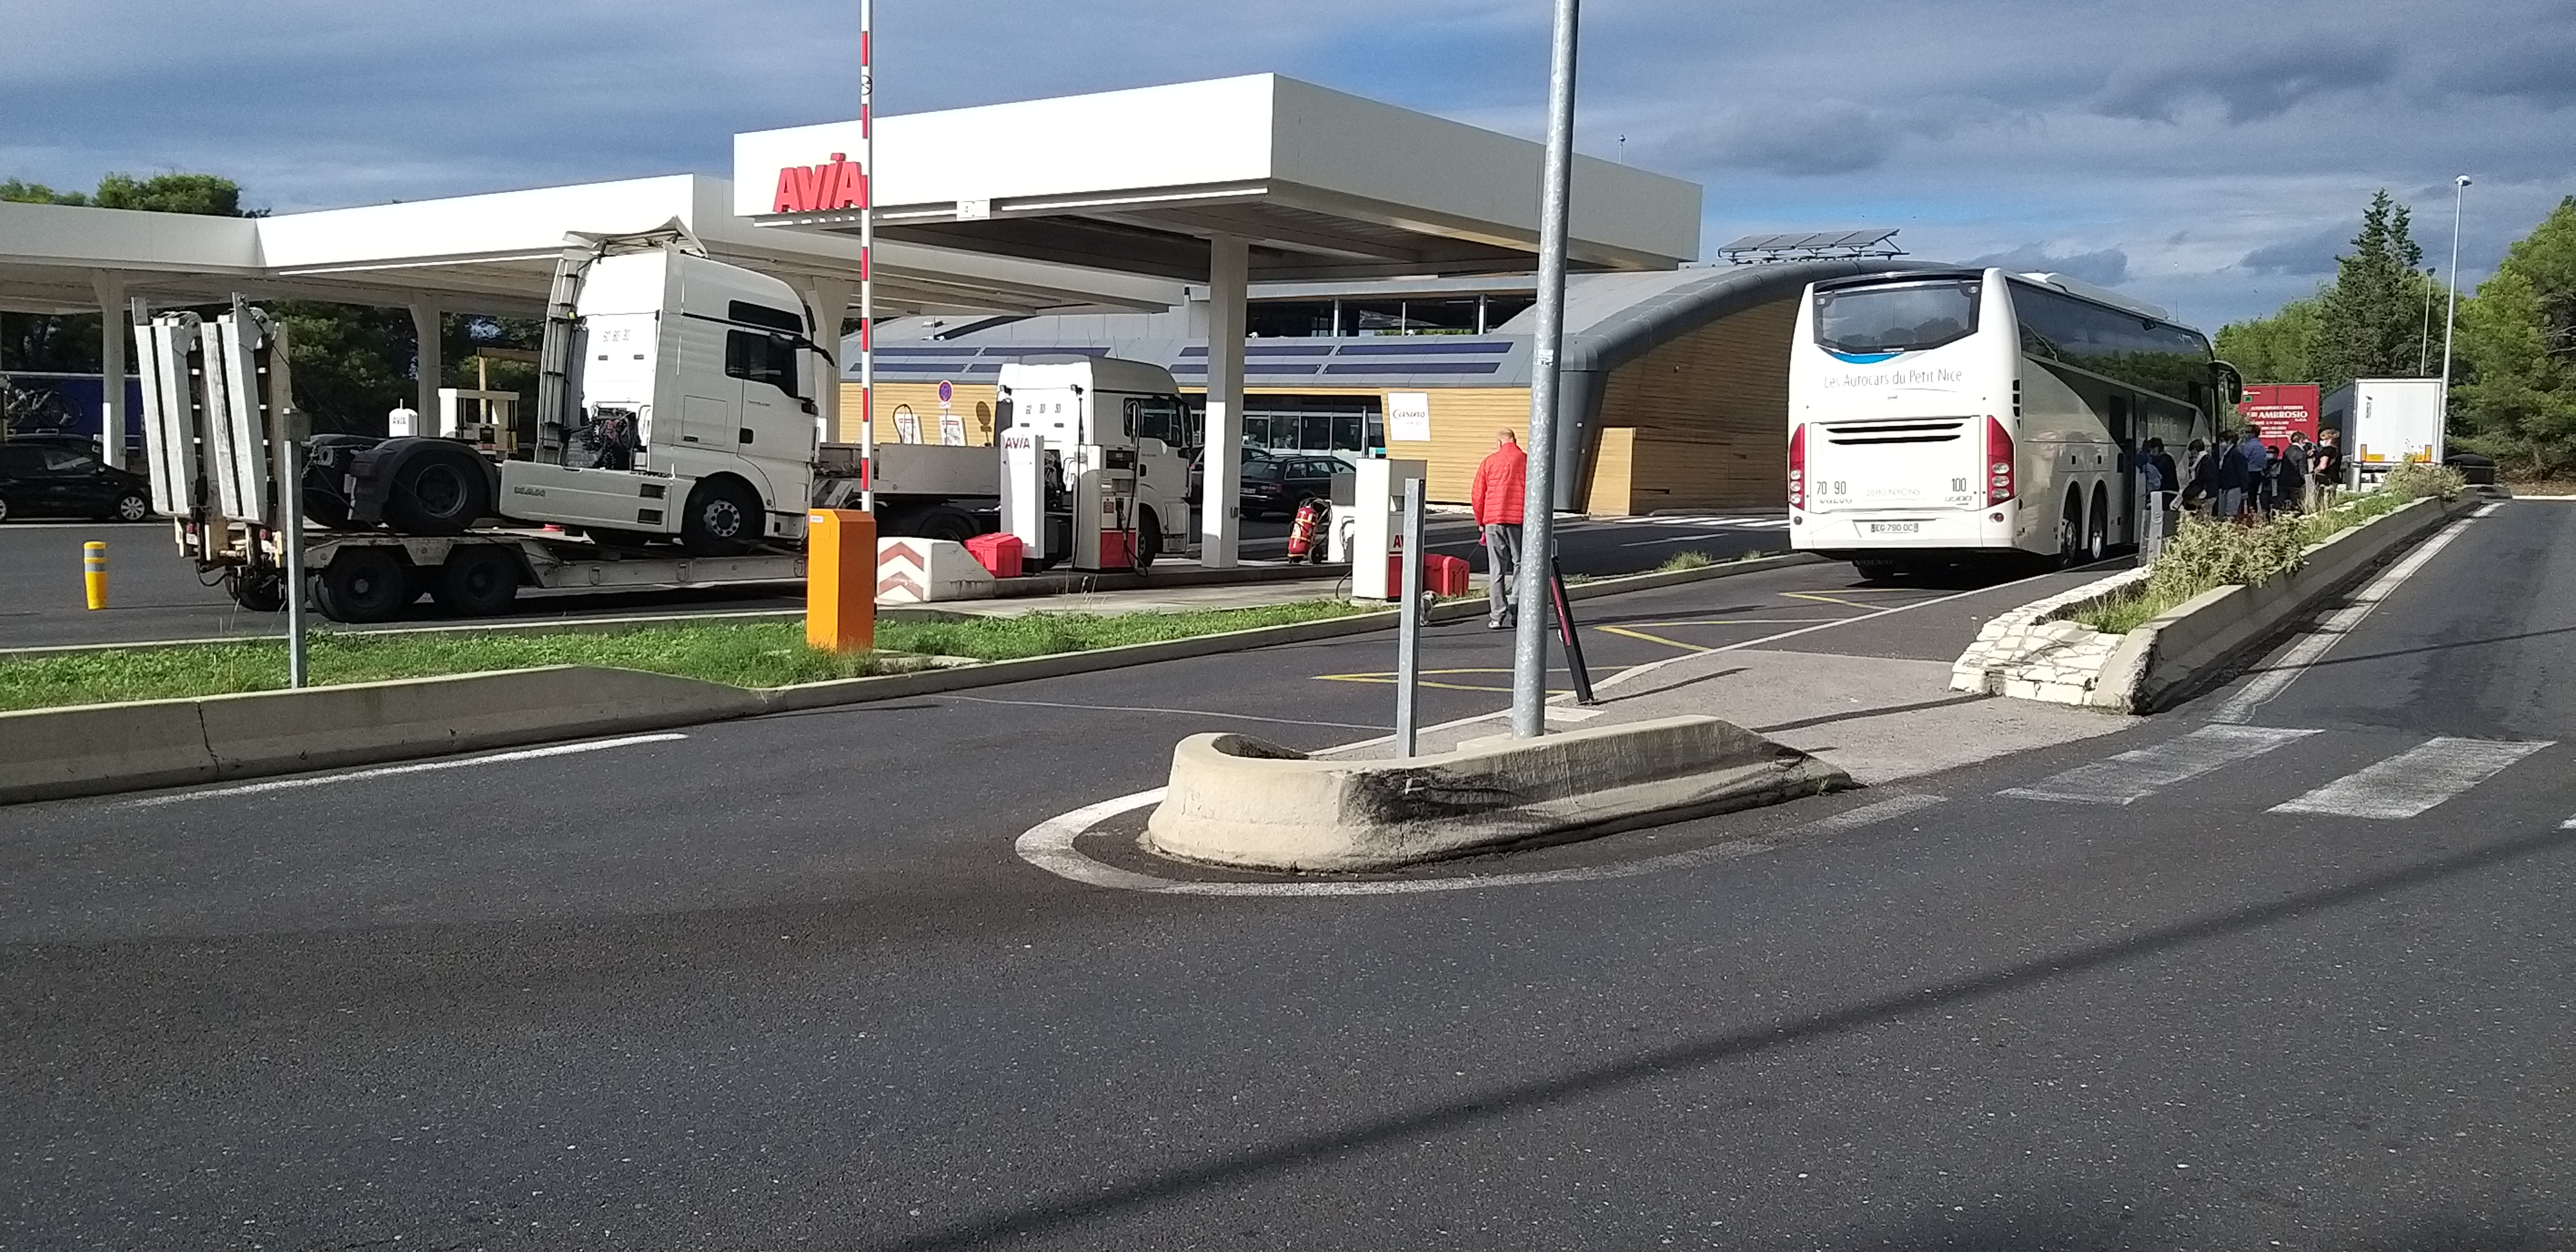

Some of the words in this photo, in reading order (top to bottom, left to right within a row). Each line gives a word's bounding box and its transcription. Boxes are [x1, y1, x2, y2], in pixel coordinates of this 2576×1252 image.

[1824, 375, 1840, 388] Les
[1844, 374, 1889, 387] Autocars
[1892, 370, 1905, 384] du
[1910, 370, 1933, 384] Petit
[1938, 369, 1962, 382] Nice
[1393, 409, 1425, 419] Casino
[2259, 411, 2308, 419] AMBROSIO
[1817, 481, 1827, 495] 70
[1834, 481, 1846, 495] 90
[1952, 478, 1966, 492] 100
